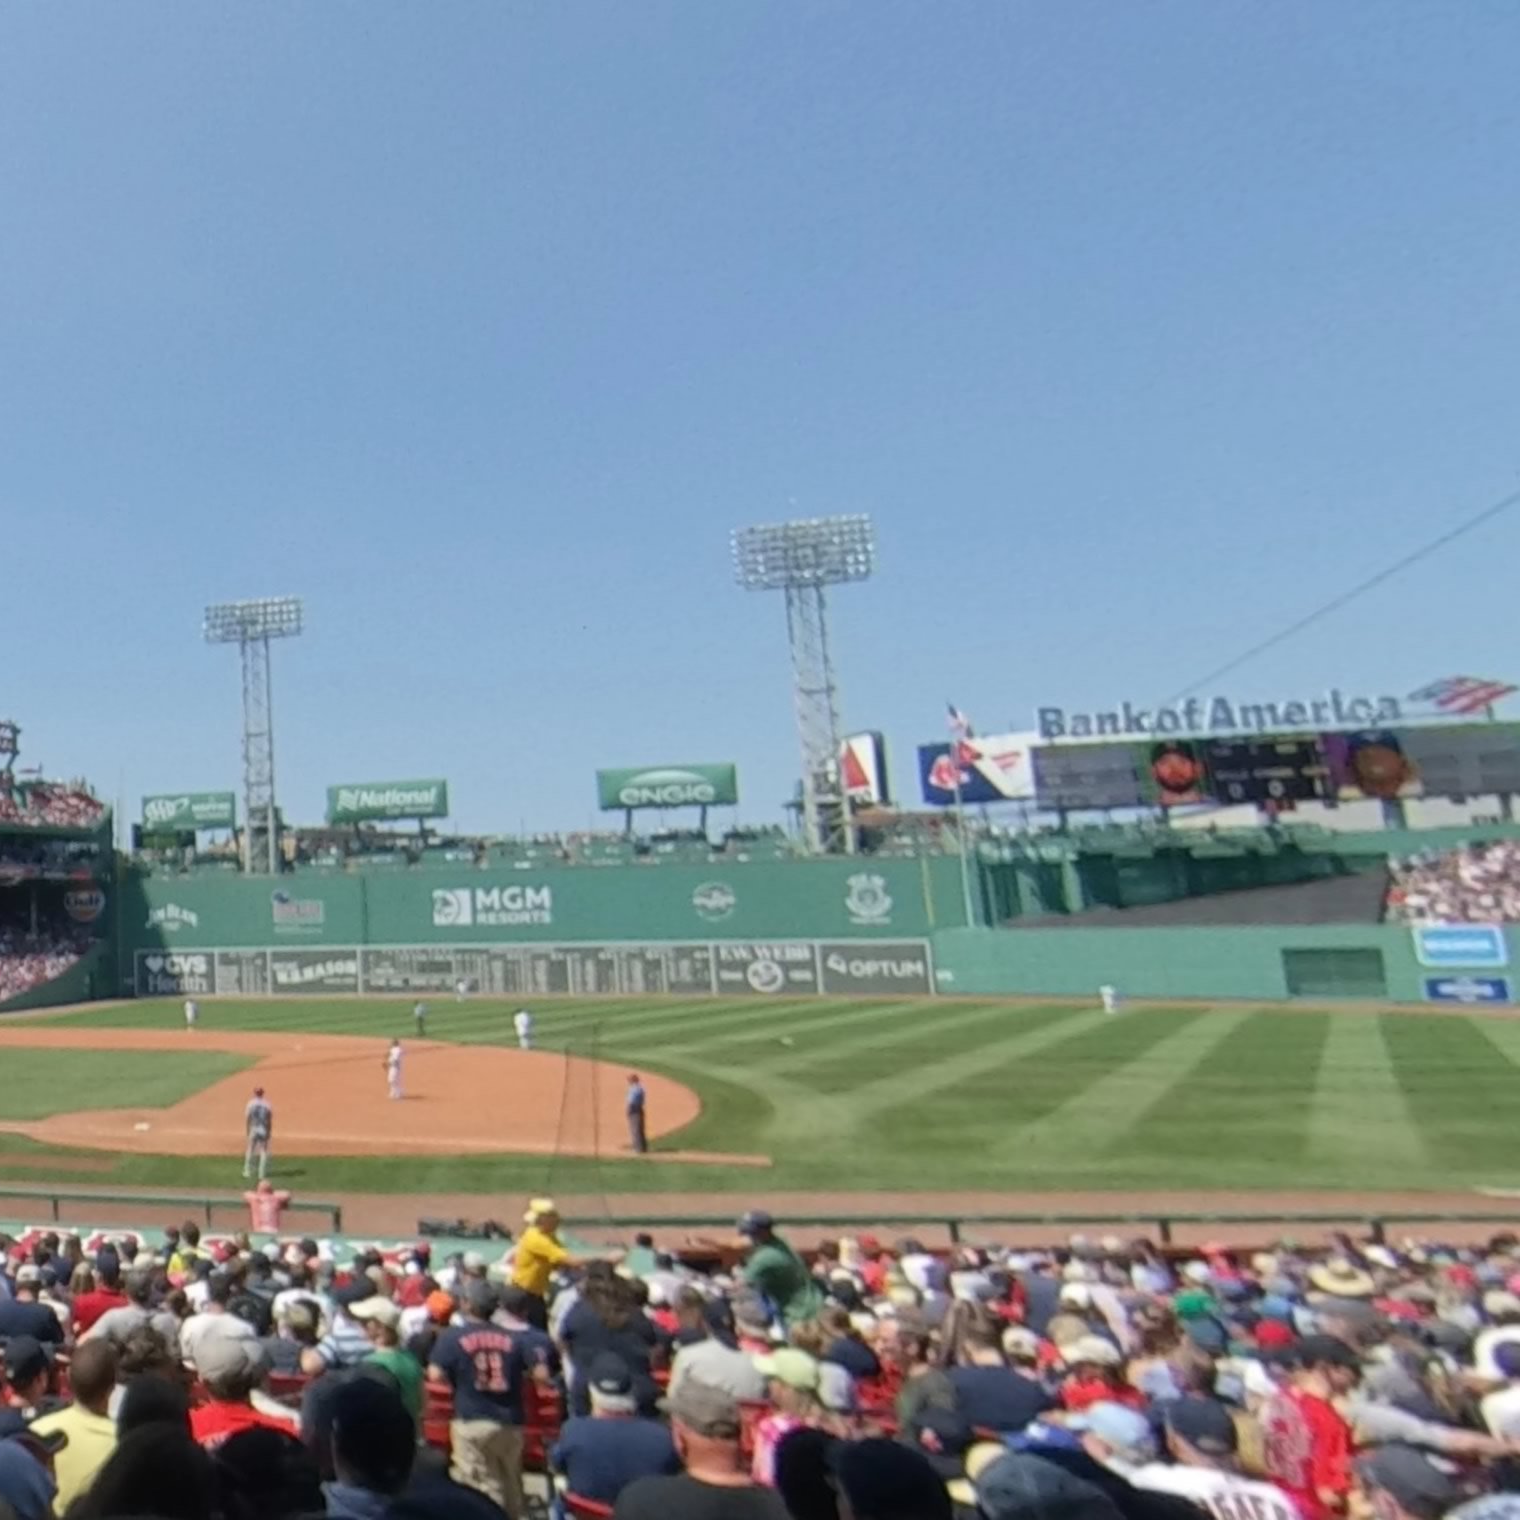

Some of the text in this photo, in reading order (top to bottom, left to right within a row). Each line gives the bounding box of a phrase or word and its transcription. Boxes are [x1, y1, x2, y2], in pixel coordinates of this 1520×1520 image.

[1038, 688, 1401, 738] Bank of America
[360, 787, 437, 808] National
[476, 886, 551, 910] MGM
[476, 910, 551, 925] RESORTS
[165, 955, 207, 975] CVS
[849, 959, 923, 978] OPTUM
[148, 974, 207, 992] Health
